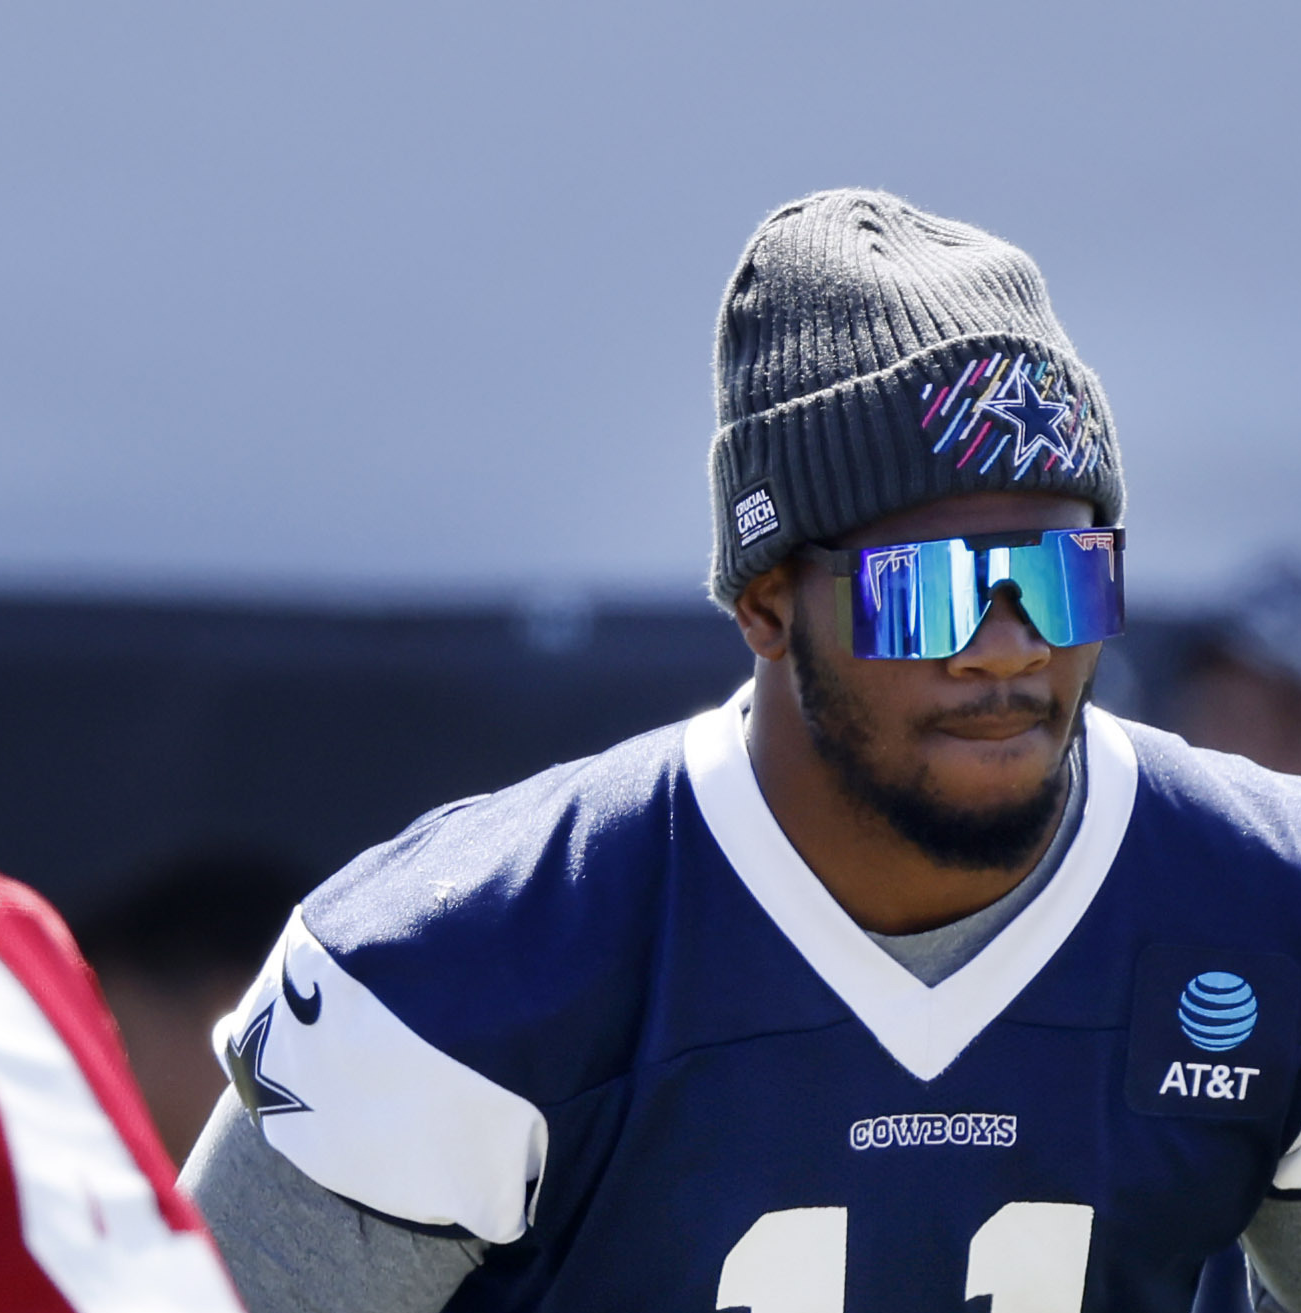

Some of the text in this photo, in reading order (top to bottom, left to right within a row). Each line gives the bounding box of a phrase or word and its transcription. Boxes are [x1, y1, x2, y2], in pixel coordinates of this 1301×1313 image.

[735, 488, 770, 518] CRUCIAL
[737, 499, 776, 535] CATCH
[1159, 1062, 1260, 1103] AT&T
[849, 1112, 1017, 1151] COWBOYS
